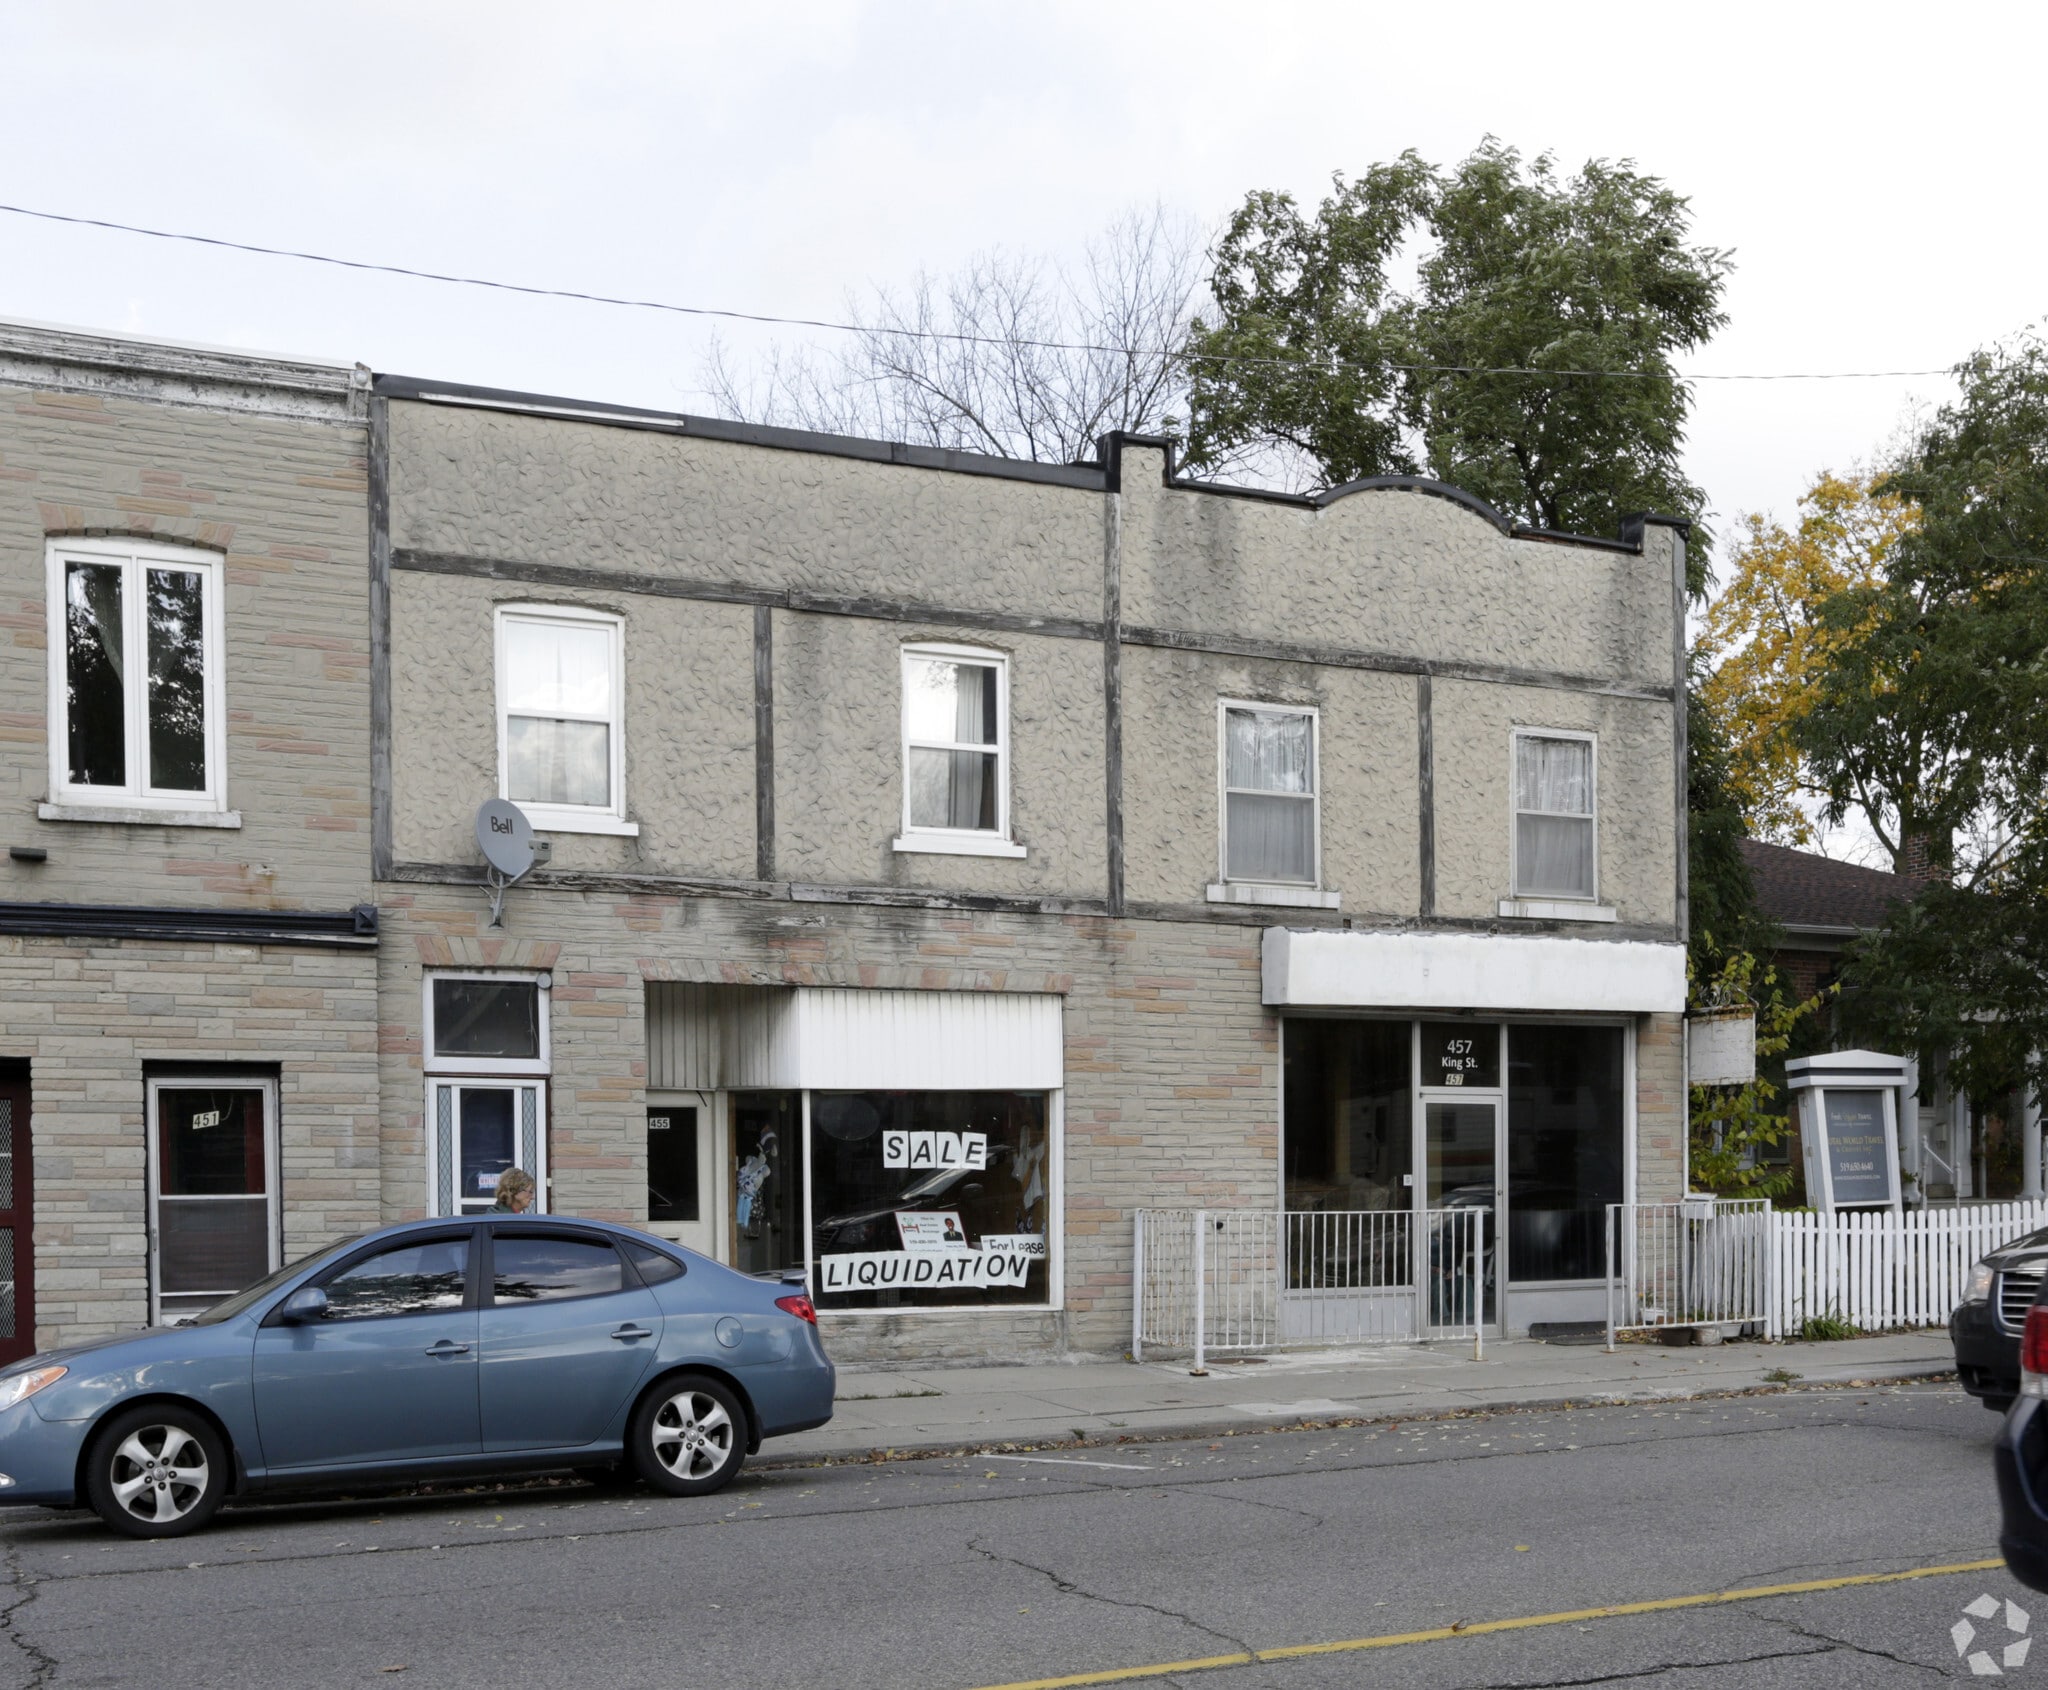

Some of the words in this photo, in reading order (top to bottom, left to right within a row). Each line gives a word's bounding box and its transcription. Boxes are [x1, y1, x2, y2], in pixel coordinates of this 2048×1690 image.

[491, 816, 513, 834] Bell
[1447, 1040, 1472, 1054] 457
[1442, 1056, 1463, 1071] King
[1465, 1057, 1478, 1068] St.
[1446, 1074, 1463, 1085] 457
[193, 1112, 217, 1128] 451
[650, 1118, 669, 1128] 455
[886, 1136, 984, 1165] SALE
[990, 1239, 1009, 1250] For
[1010, 1238, 1045, 1254] Lease
[827, 1254, 1026, 1287] LIQUIDATION
